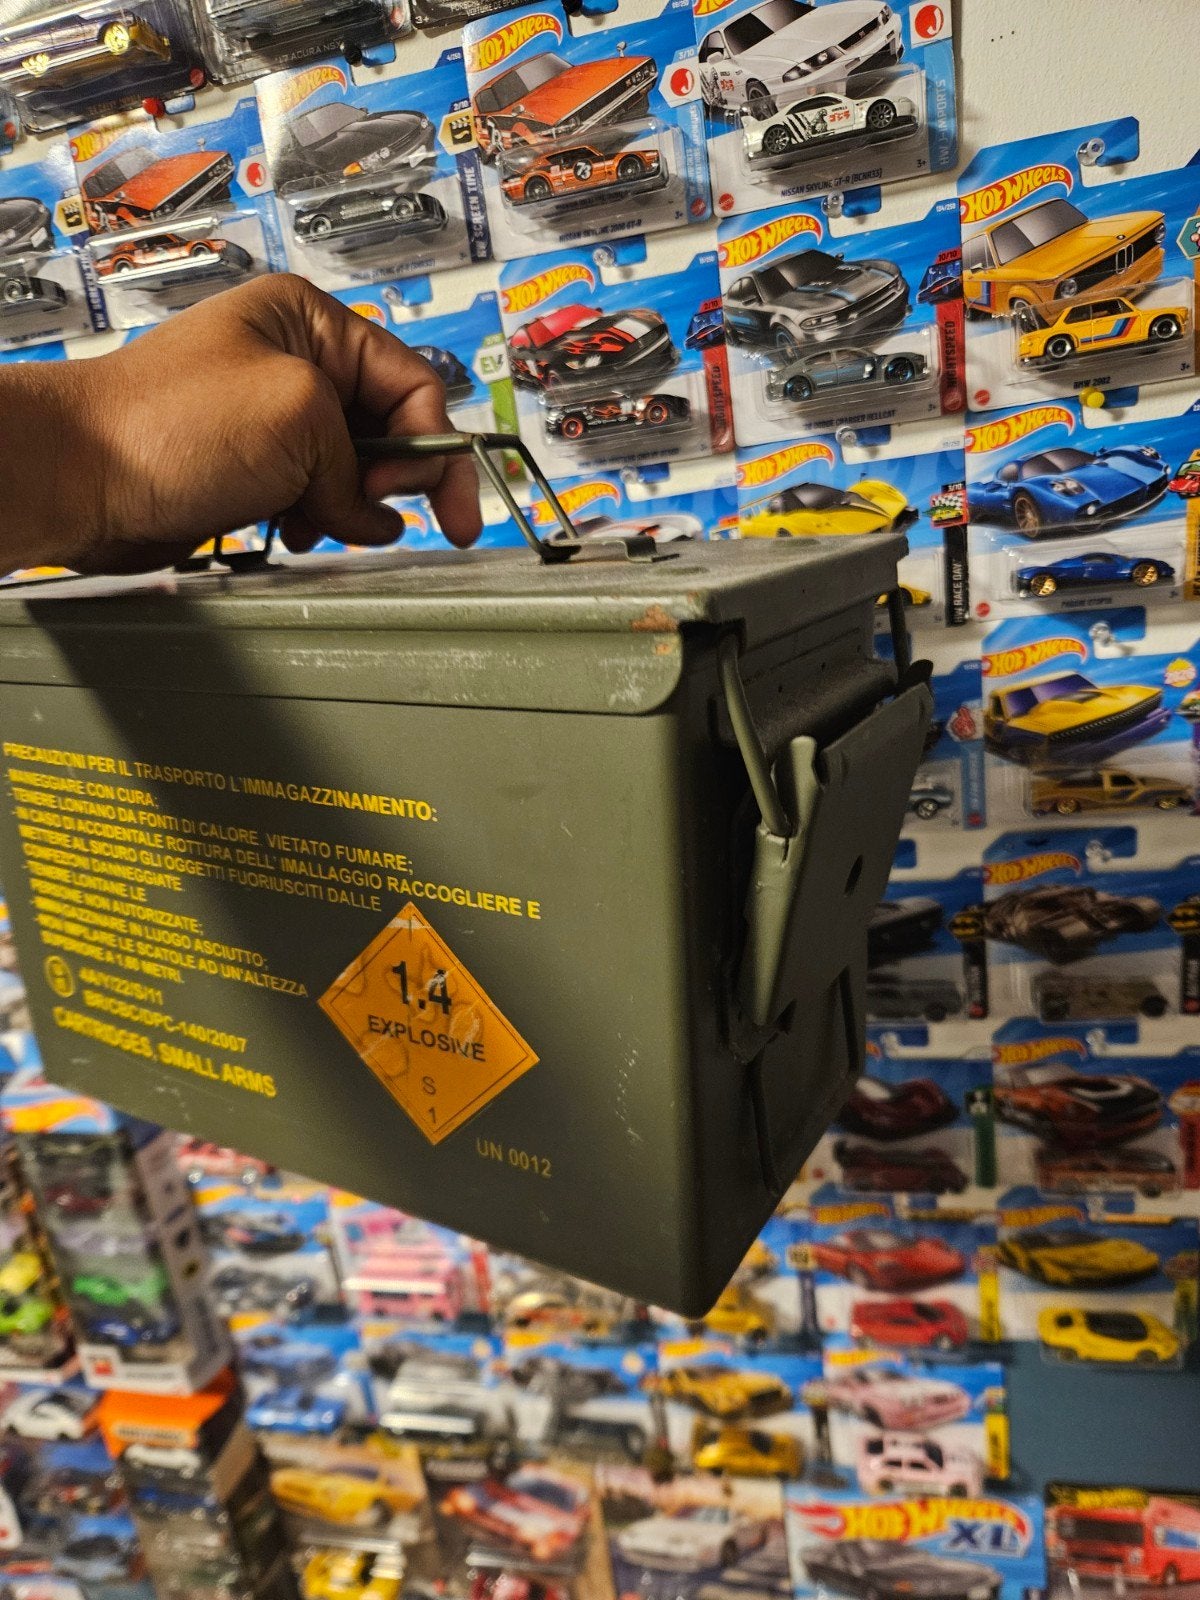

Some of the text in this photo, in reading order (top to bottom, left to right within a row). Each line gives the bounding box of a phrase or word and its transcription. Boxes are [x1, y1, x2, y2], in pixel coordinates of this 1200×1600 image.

[291, 45, 321, 61] ACURA
[463, 166, 477, 194] TIME
[576, 161, 592, 180] 73
[781, 185, 805, 198] NISSAN
[805, 180, 832, 193] SKYLINE
[468, 196, 484, 237] SCREEN
[952, 562, 962, 581] DAY
[952, 582, 963, 606] RACE
[86, 781, 116, 800] CON
[87, 755, 117, 774] PER
[118, 759, 133, 777] IL
[133, 762, 227, 791] TRASPORTO
[230, 776, 438, 822] L'IMMAGAZZINAMENTO:
[59, 797, 117, 821] LONTANO
[117, 806, 138, 825] DA
[138, 809, 179, 832] FONTI
[182, 818, 197, 835] DI
[266, 832, 332, 860] VIETATO
[335, 844, 414, 876] FUMARE;
[76, 819, 164, 850] ACCIDENTALE
[165, 834, 234, 862] ROTTURA
[235, 848, 276, 870] DELL'
[280, 857, 383, 891] IMALLAGGIO
[386, 875, 523, 917] RACCOGLIERE
[526, 900, 542, 920] E
[90, 840, 138, 863] SICURO
[139, 850, 162, 868] GLI
[163, 855, 225, 879] OGGETTI
[228, 868, 324, 901] FUORIUSCITI
[326, 886, 383, 912] DALLE
[129, 885, 147, 902] LE
[143, 926, 192, 950] LUOGO
[118, 936, 135, 953] LE
[136, 941, 197, 970] SCATOLE
[197, 957, 219, 976] AD
[220, 963, 309, 999] UN'ALTEZZA
[391, 960, 453, 1015] 1.4
[367, 1014, 486, 1063] EXPLOSIVE
[158, 1042, 221, 1081] SMALL
[220, 1062, 278, 1098] ARMS
[421, 1075, 437, 1096] S
[427, 1106, 437, 1124] 1
[475, 1137, 552, 1179] UN 0012
